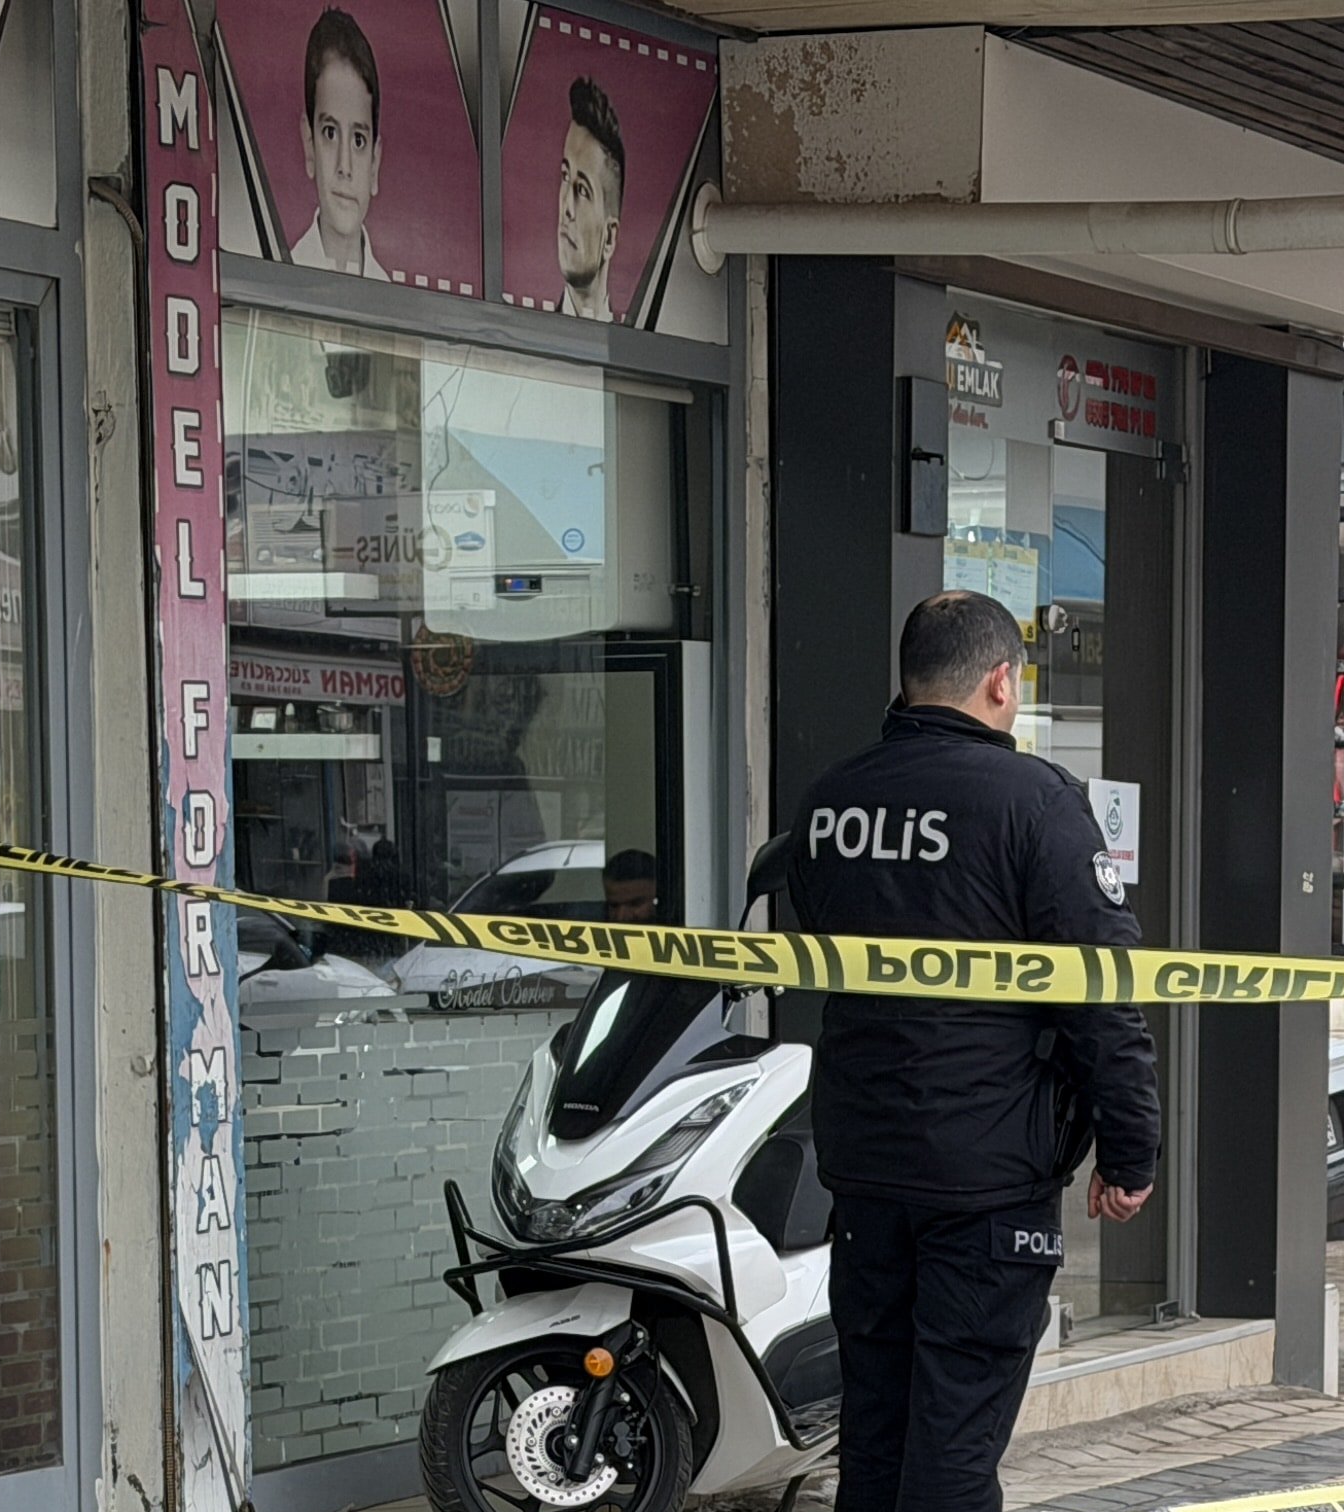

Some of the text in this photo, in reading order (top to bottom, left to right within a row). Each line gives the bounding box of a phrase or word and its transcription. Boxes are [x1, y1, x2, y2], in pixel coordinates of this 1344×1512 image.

[155, 66, 234, 1341] MODEL FOR MAN
[957, 364, 1000, 400] EMLAK
